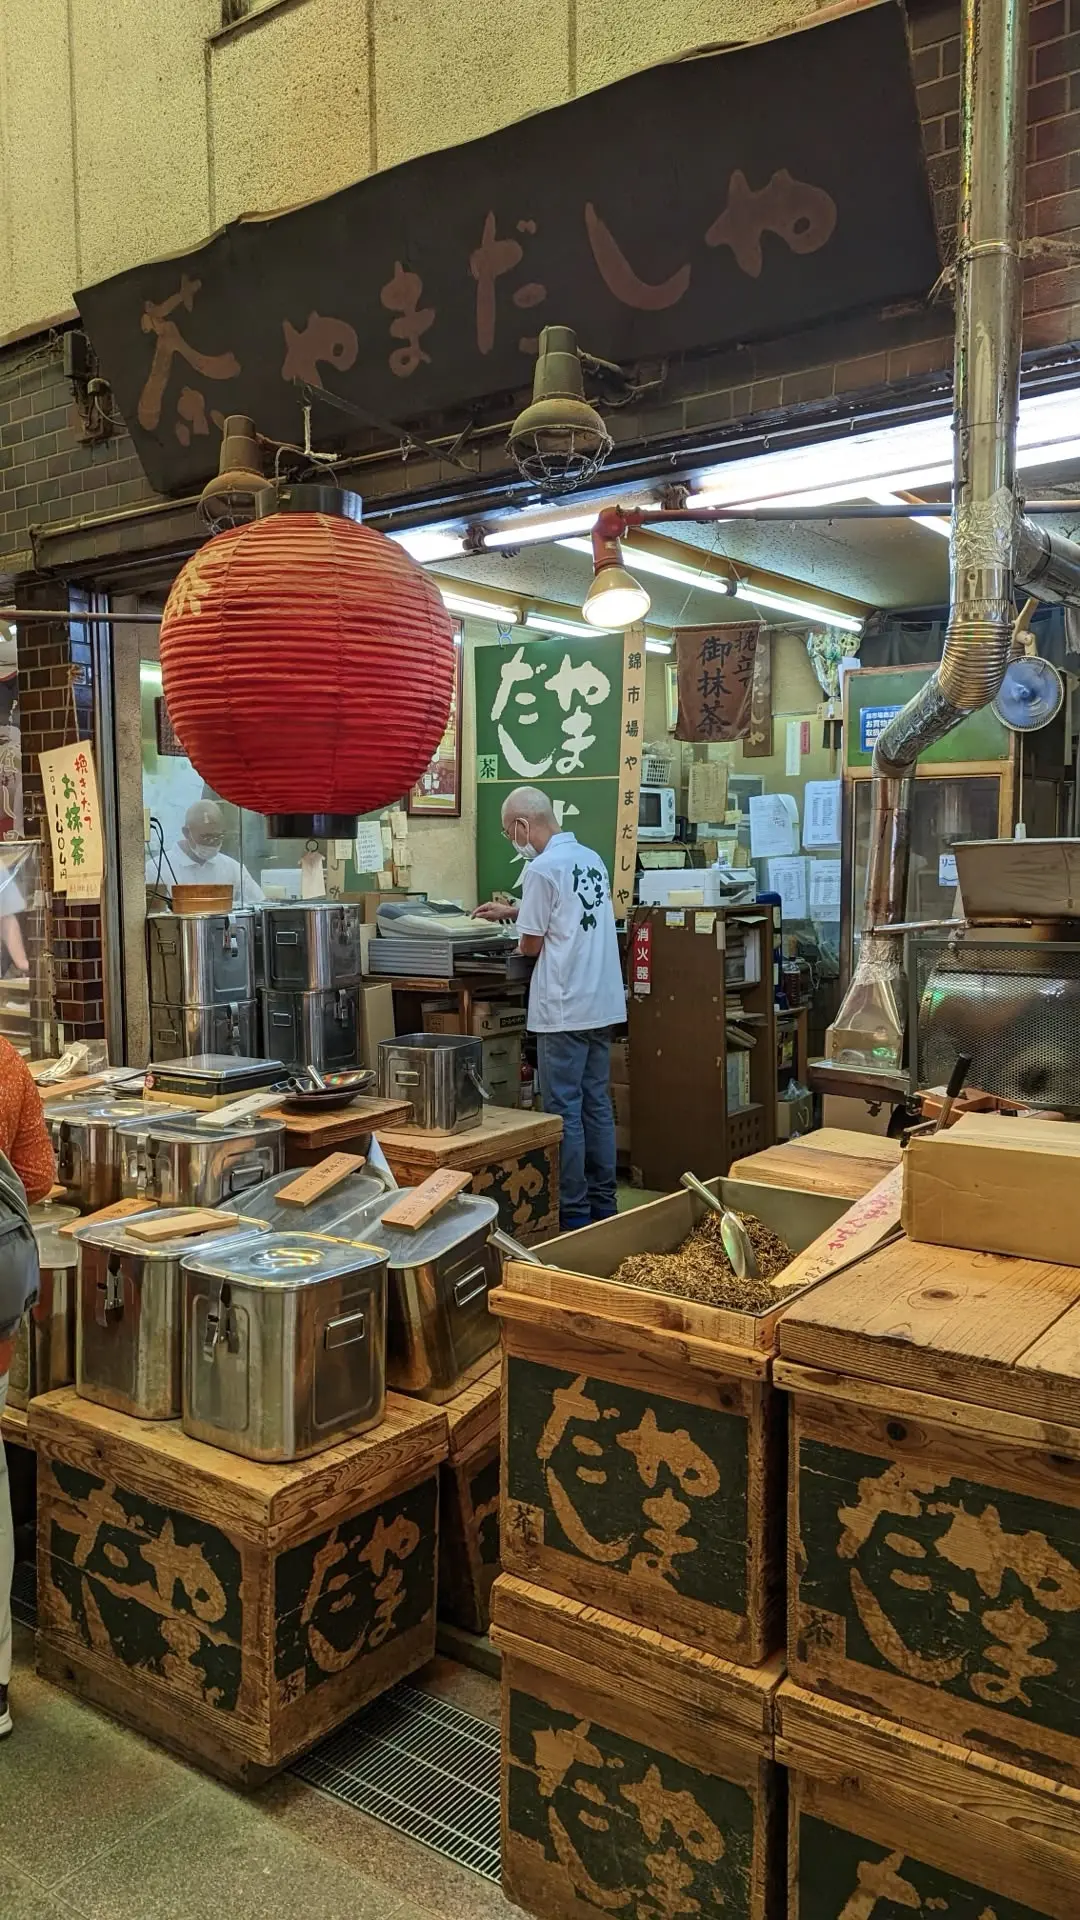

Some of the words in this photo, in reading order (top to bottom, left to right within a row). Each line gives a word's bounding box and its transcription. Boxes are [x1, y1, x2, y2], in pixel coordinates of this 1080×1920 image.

[697, 636, 732, 735] 御抹茶
[479, 758, 497, 780] 茶
[617, 652, 643, 904] 錦市場やまだしや
[61, 774, 84, 866] お抹茶
[636, 928, 649, 980] 消火器
